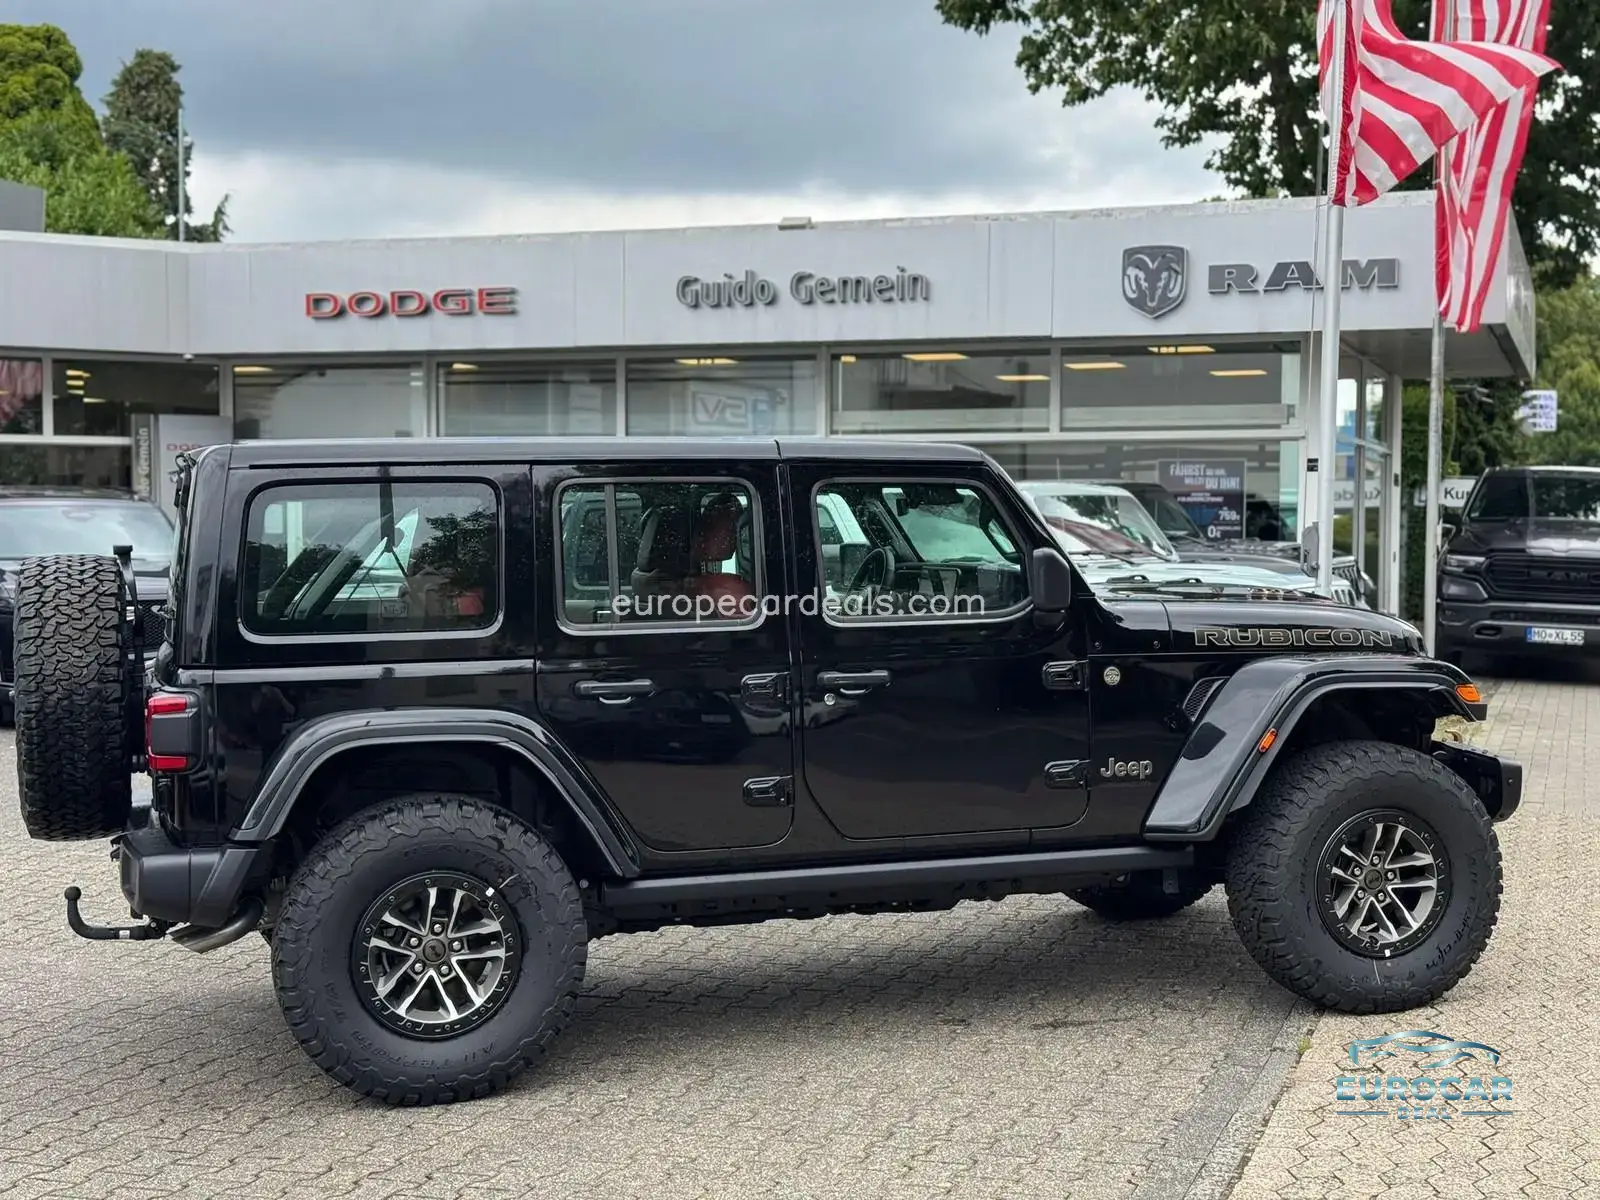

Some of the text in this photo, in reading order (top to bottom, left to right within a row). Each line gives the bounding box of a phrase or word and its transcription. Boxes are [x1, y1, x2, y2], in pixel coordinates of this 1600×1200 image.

[676, 265, 932, 308] Guido Gemein
[1208, 258, 1400, 294] RAM
[305, 286, 518, 318] DODGE
[1194, 628, 1393, 646] RUBICON
[1100, 757, 1153, 780] Jeep
